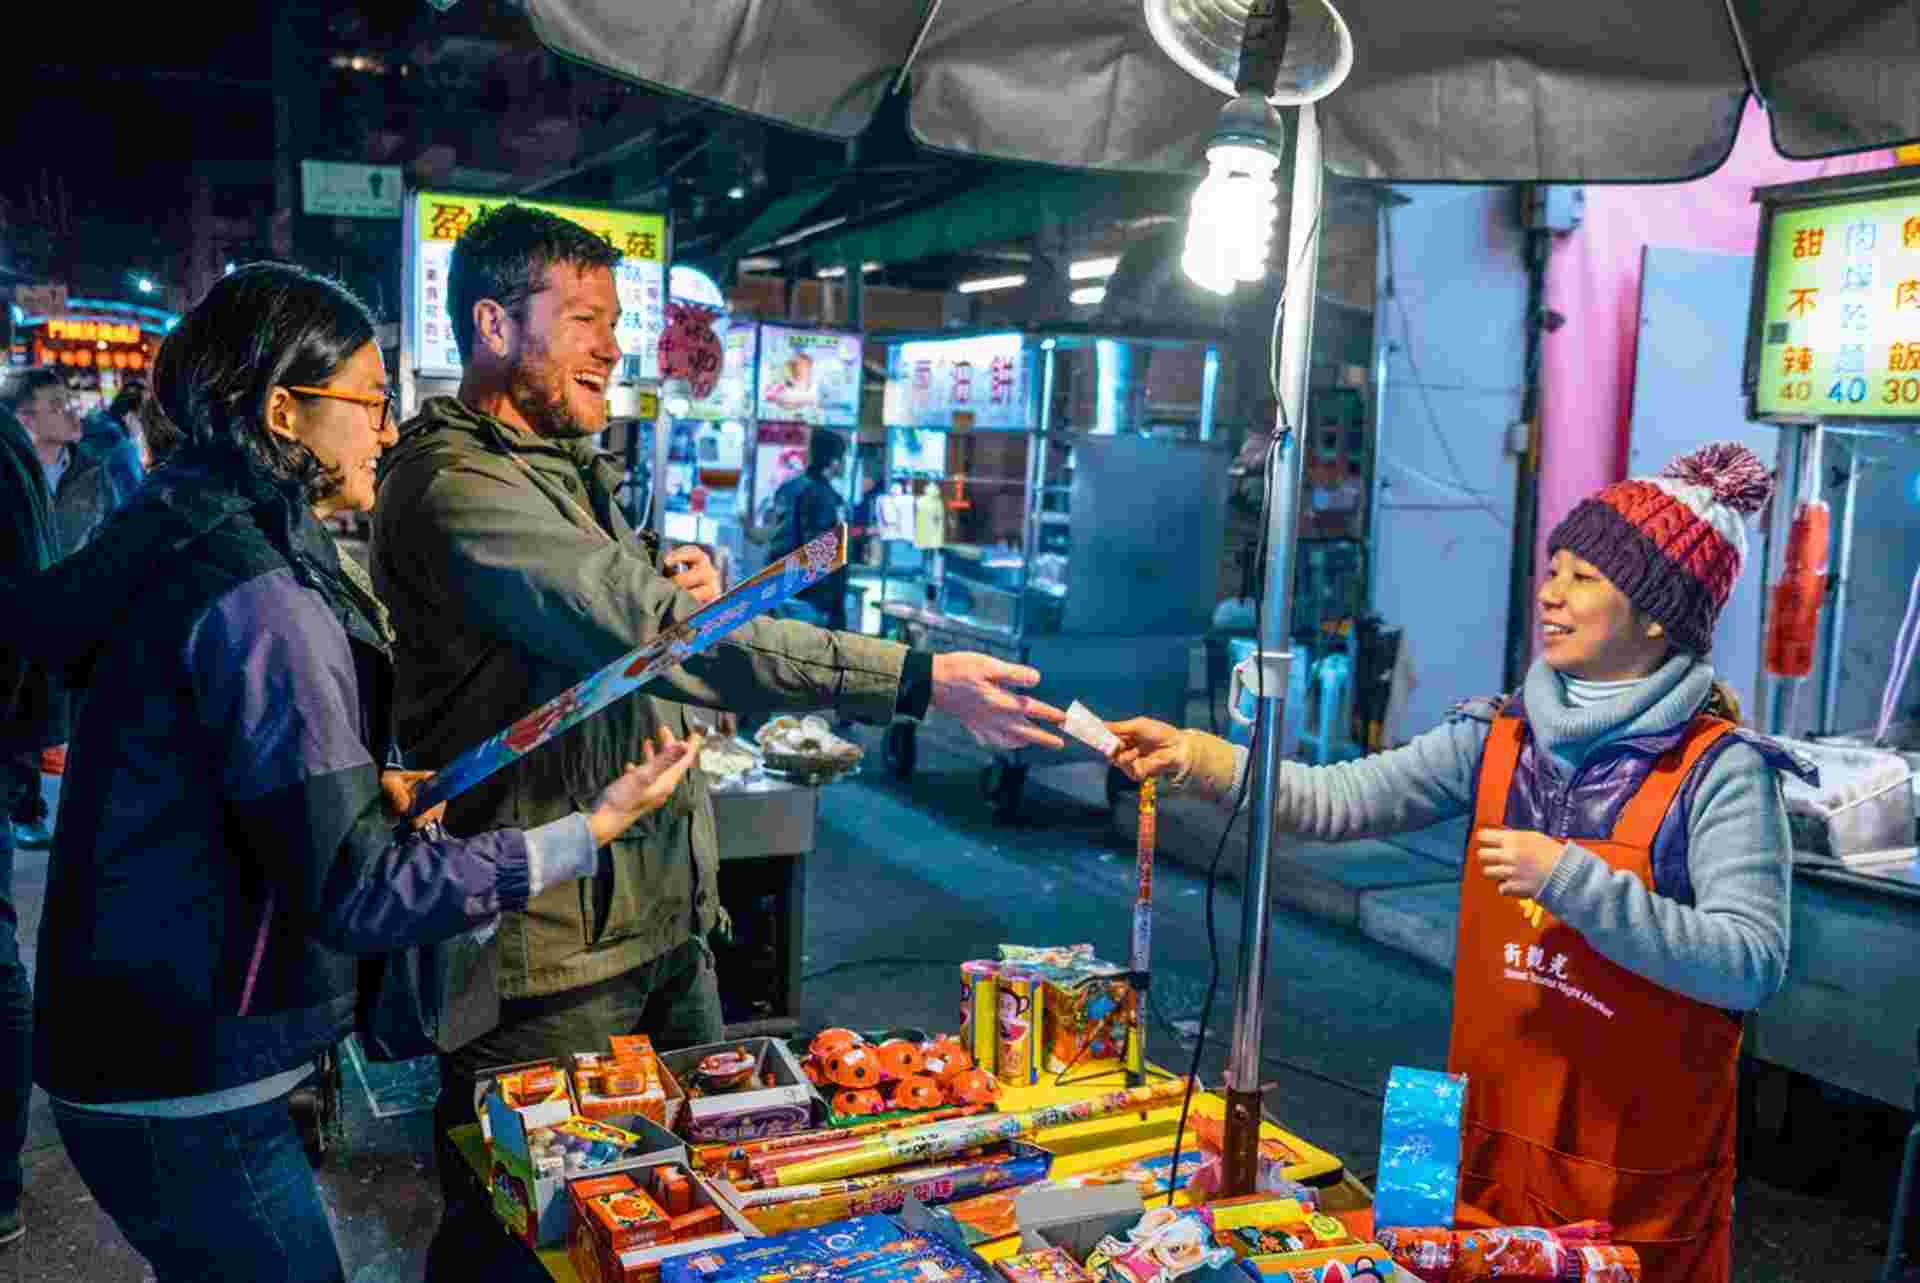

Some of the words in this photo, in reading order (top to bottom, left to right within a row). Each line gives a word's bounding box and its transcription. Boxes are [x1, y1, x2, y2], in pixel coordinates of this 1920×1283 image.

[1783, 227, 1825, 376] 甜不辣
[1781, 380, 1810, 401] 40
[1829, 377, 1867, 403] 40
[1882, 377, 1920, 404] 30
